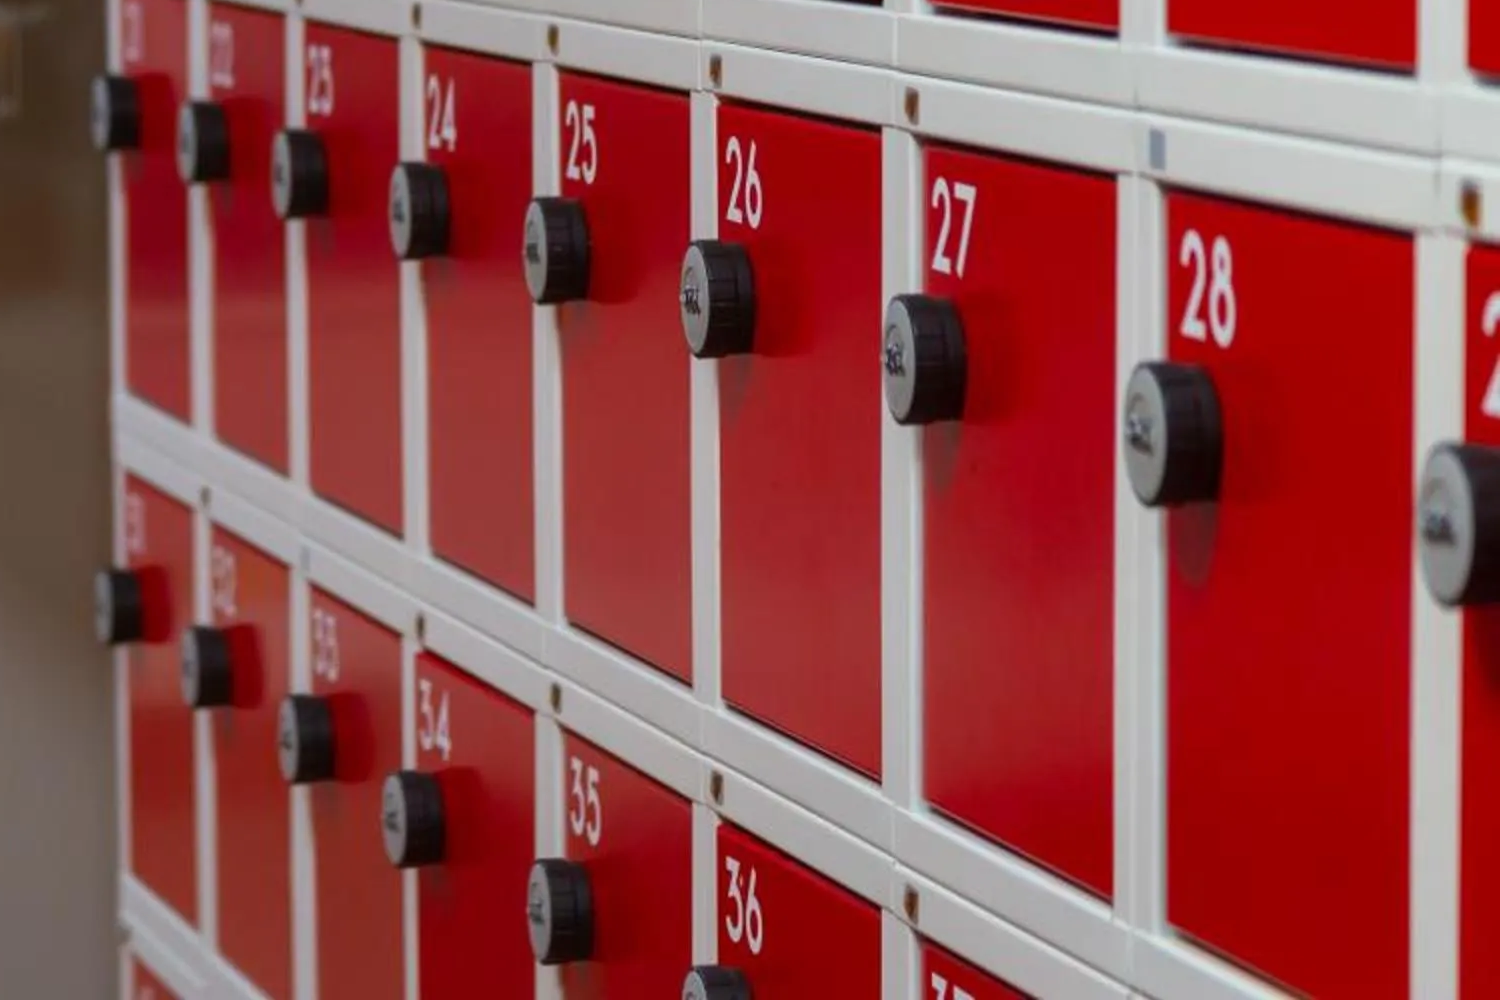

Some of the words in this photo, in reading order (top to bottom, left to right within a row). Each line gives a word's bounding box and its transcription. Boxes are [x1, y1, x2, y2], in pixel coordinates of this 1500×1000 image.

[307, 45, 334, 116] 23
[426, 74, 457, 152] 24
[565, 100, 598, 185] 25
[725, 135, 763, 229] 26
[931, 176, 977, 279] 27
[1180, 229, 1236, 348] 28
[1481, 290, 1500, 418] 2
[312, 607, 340, 683] 33
[419, 679, 452, 762] 34
[569, 755, 601, 846] 35
[725, 856, 763, 955] 36
